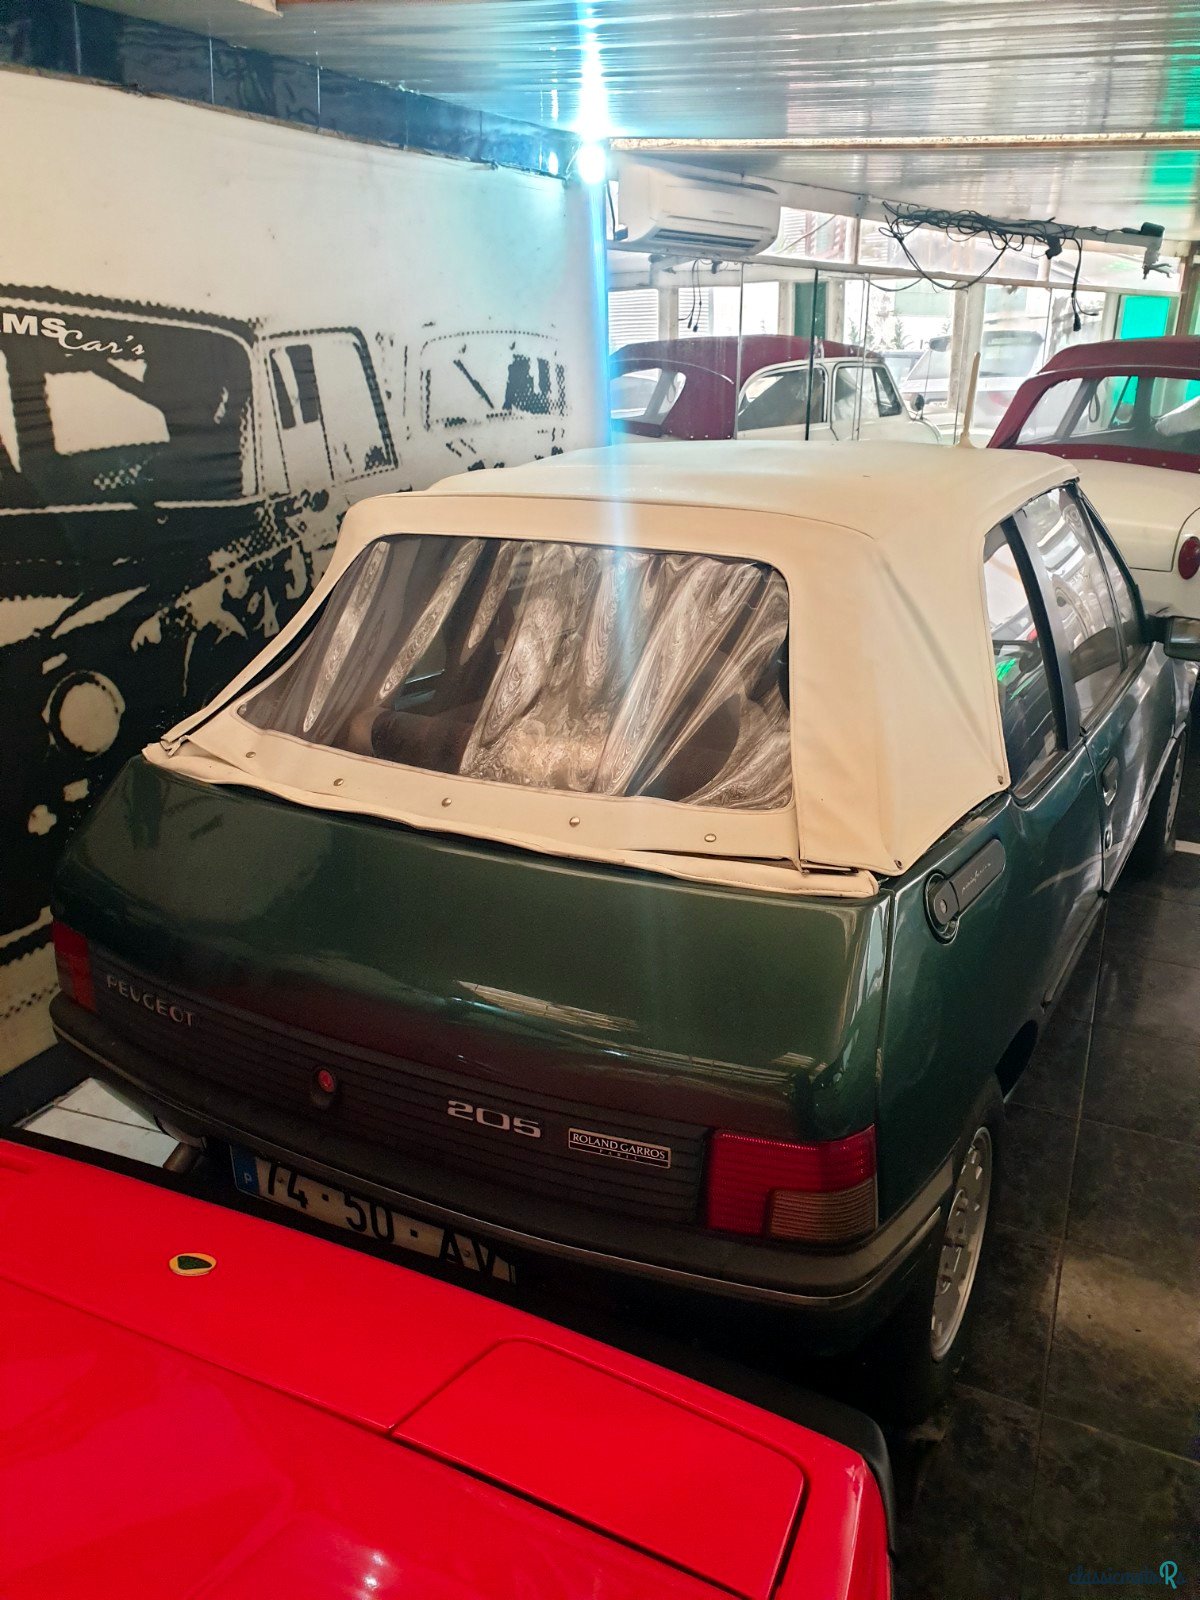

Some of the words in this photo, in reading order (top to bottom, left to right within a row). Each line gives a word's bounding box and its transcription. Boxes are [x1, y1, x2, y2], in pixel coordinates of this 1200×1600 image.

[0, 313, 66, 338] MS
[58, 329, 145, 355] Car's
[106, 974, 194, 1027] PEUGEOT
[447, 1099, 541, 1138] 205
[573, 1133, 618, 1150] ROLAND
[619, 1142, 666, 1160] GARROS
